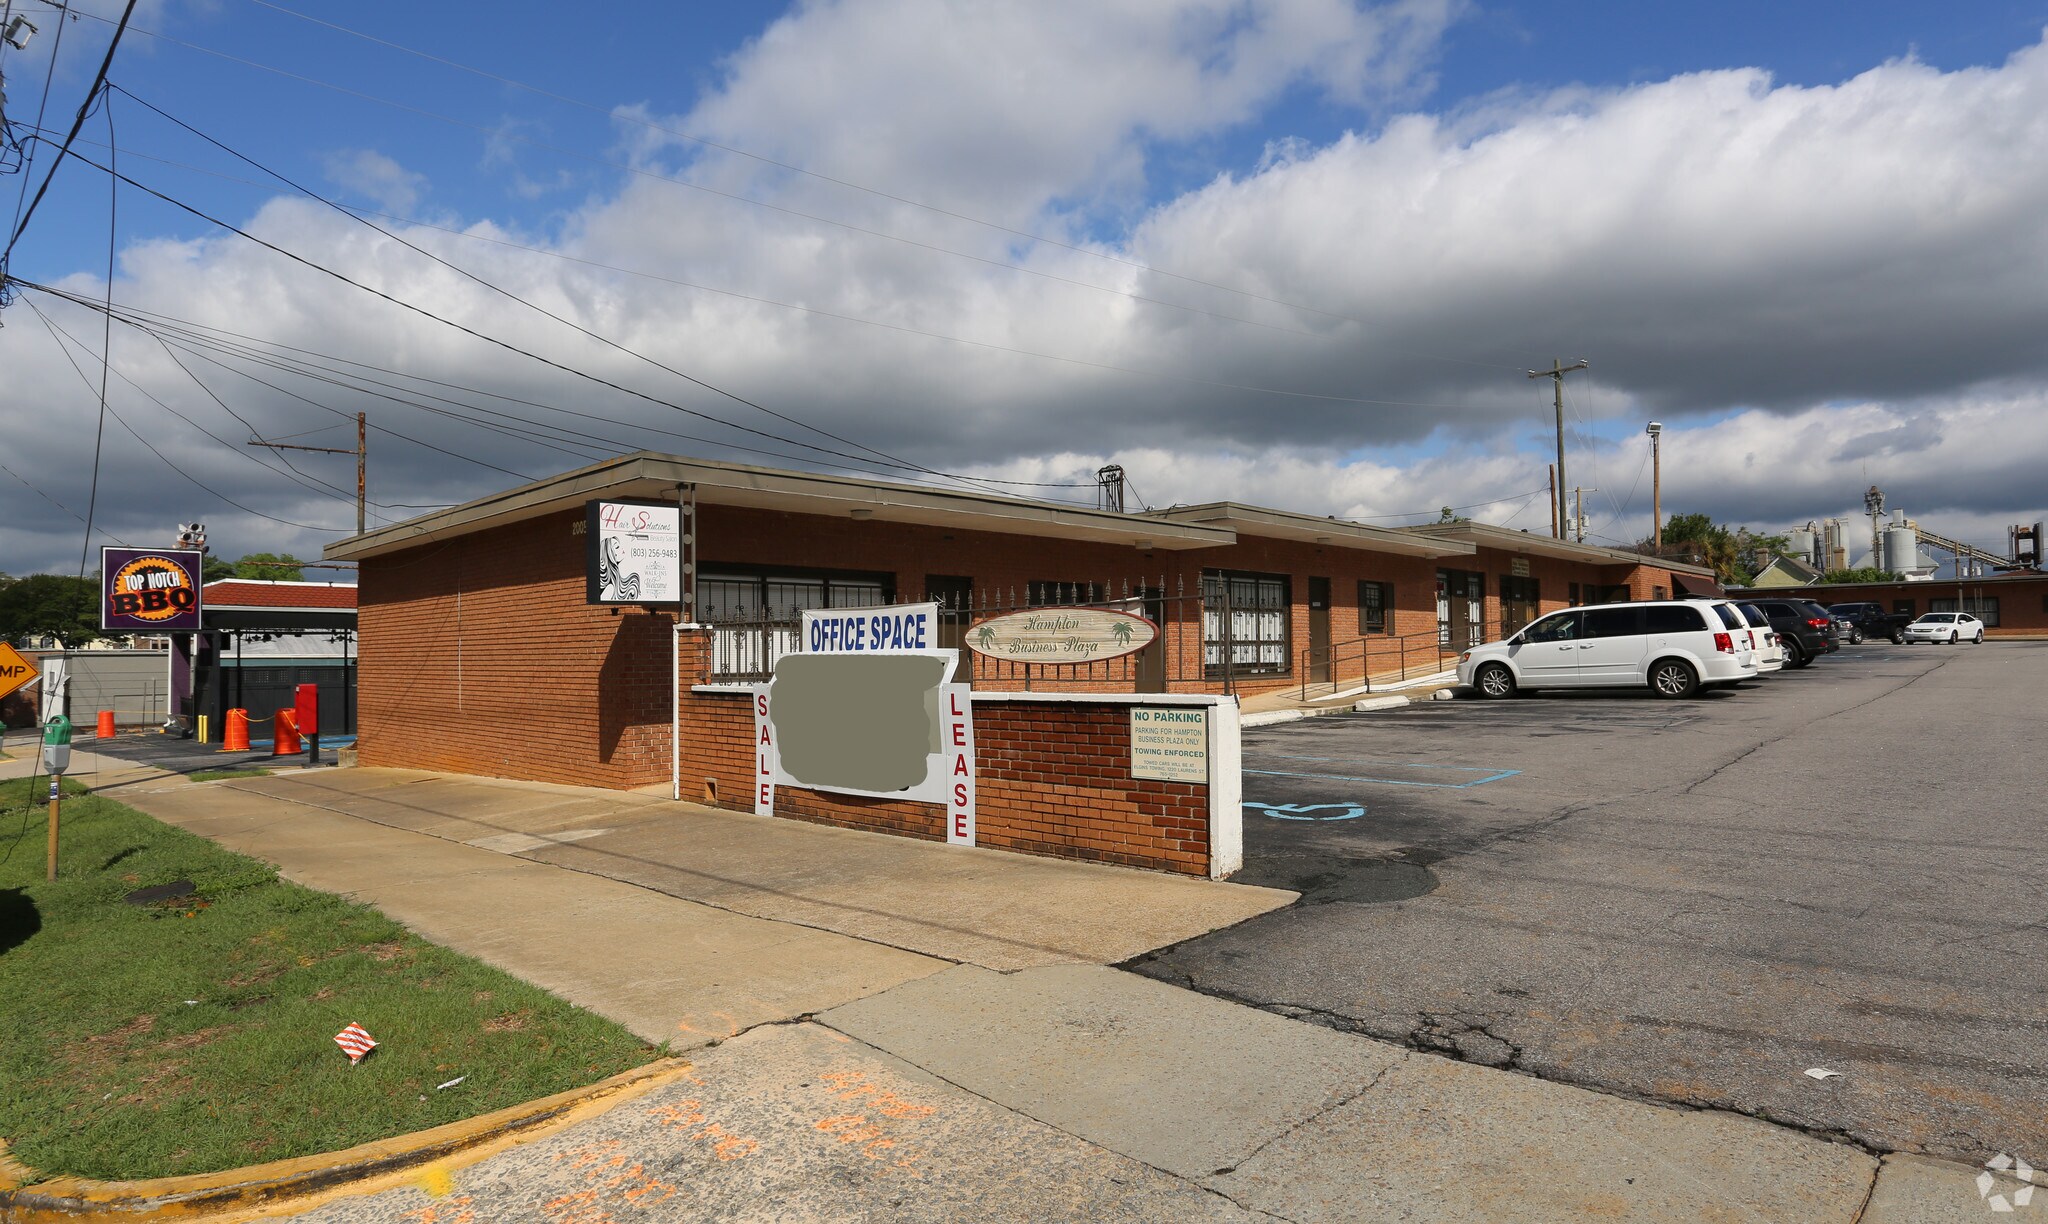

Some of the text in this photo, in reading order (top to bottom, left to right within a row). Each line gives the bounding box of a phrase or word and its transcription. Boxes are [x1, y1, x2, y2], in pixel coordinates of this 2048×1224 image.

[601, 504, 671, 531] Hair Solutions
[630, 548, 678, 559] (803) 256-9483
[124, 571, 180, 591] TOP NOTCH
[110, 587, 196, 616] BBQ
[811, 613, 927, 652] OFFICE SPACE
[1023, 614, 1080, 635] Hampton
[1008, 635, 1099, 658] Business Plaza
[1135, 712, 1202, 723] NO PARKING
[758, 694, 771, 805] SALE
[1166, 737, 1184, 745] PLAZA
[1185, 738, 1200, 746] ONLY
[950, 693, 969, 838] LEASE
